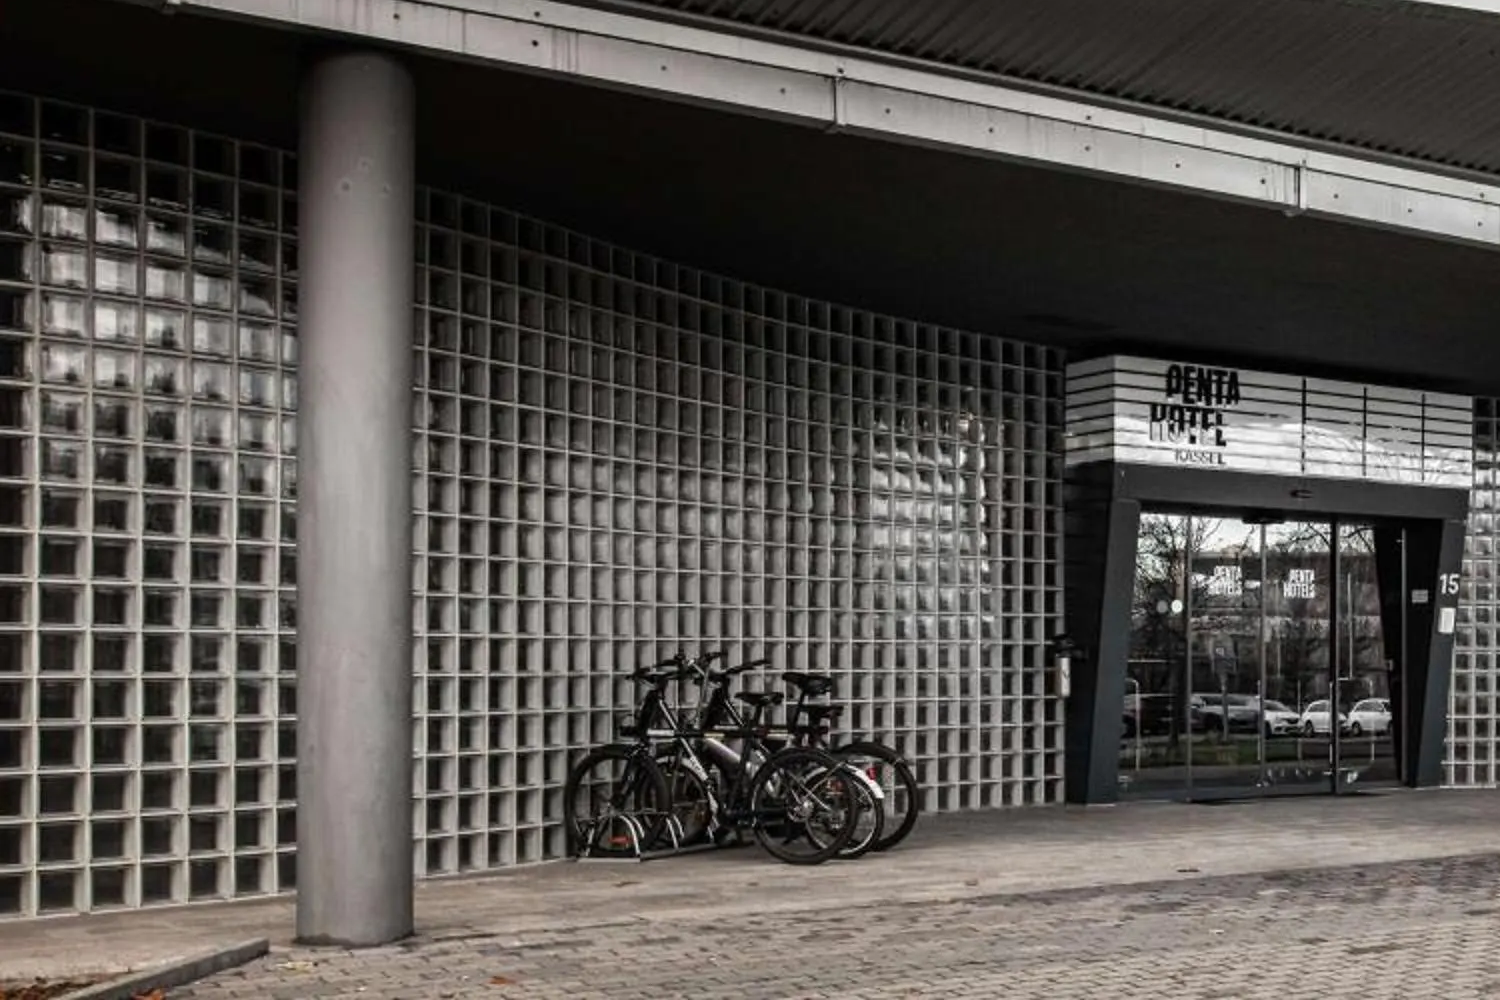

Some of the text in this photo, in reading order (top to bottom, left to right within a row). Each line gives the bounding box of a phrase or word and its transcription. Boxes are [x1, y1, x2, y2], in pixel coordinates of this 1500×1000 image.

[1166, 364, 1240, 406] PENTA
[1150, 404, 1227, 447] HOTEL
[1440, 573, 1460, 595] 15
